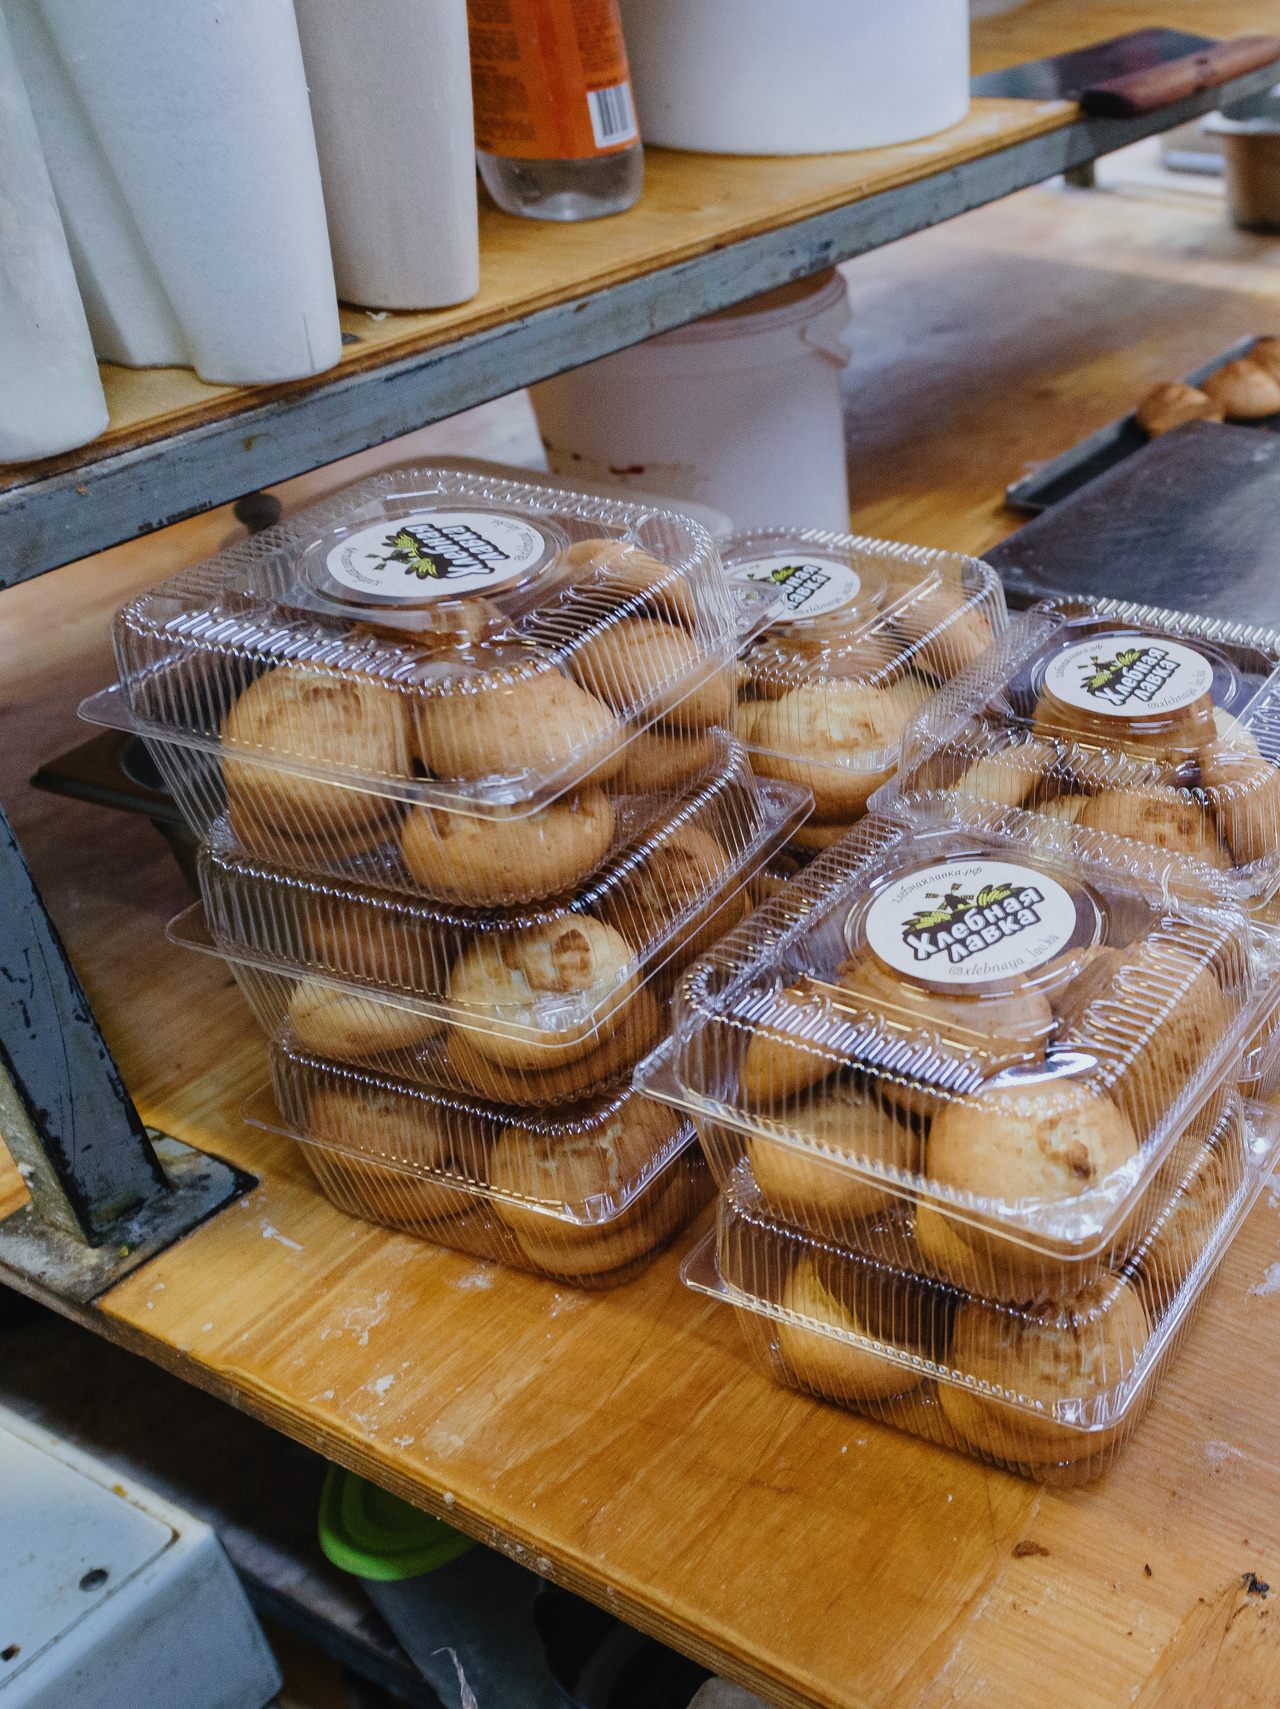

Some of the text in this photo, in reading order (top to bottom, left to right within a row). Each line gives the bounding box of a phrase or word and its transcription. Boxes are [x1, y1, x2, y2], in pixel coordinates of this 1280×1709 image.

[405, 525, 491, 578] Хлебная
[441, 526, 507, 560] лавка
[1095, 647, 1166, 705] Хлебная
[1134, 660, 1178, 701] лавка
[907, 888, 1041, 960] Хлебная
[951, 909, 1038, 962] лавка
